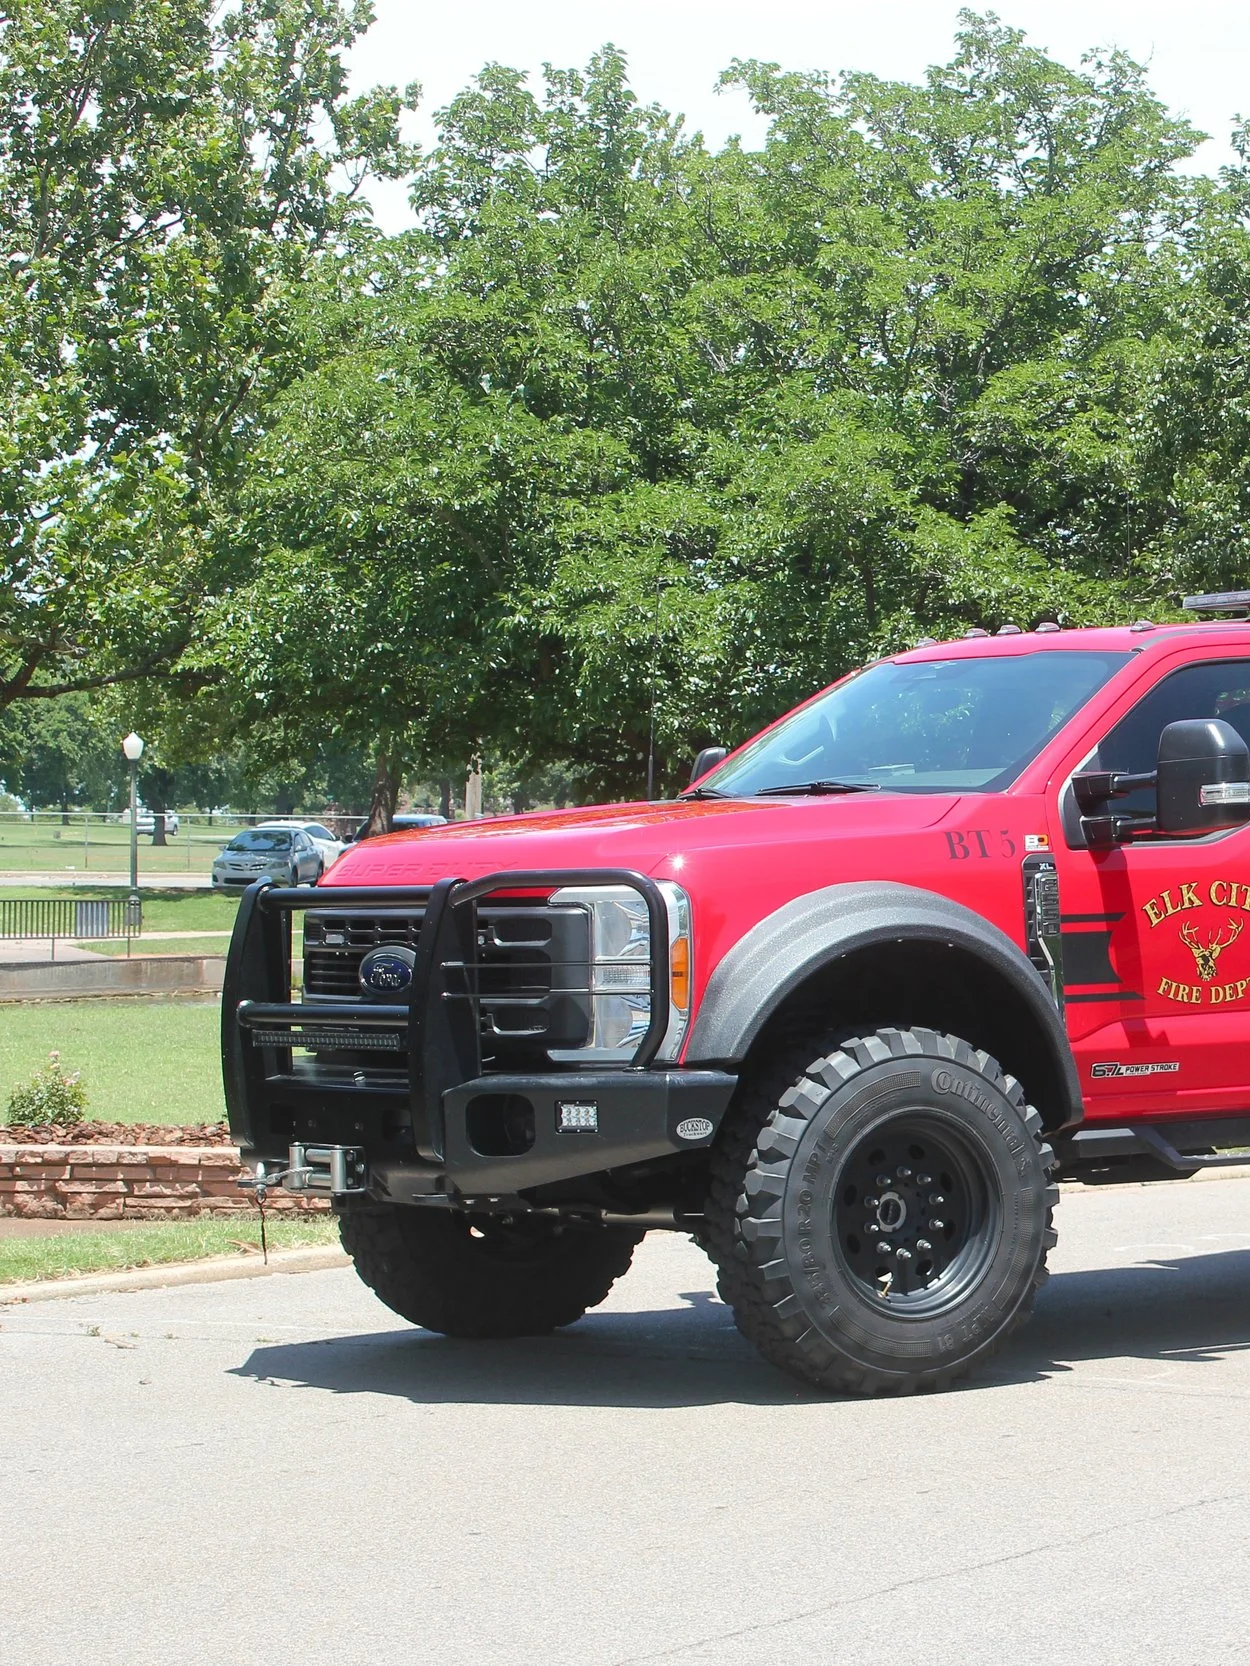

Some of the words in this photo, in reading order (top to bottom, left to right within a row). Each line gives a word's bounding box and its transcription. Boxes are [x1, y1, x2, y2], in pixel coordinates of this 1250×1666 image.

[943, 828, 992, 860] BT
[999, 829, 1016, 859] 5
[335, 862, 421, 879] SUPER
[1039, 862, 1054, 871] XL
[1142, 881, 1203, 928] ELK
[369, 962, 402, 987] Ford
[1156, 975, 1202, 1004] FIRE
[1091, 1062, 1124, 1078] 6.7L
[1124, 1065, 1150, 1074] POWER
[1150, 1063, 1178, 1072] STROKE
[930, 1067, 1027, 1156] Continental
[679, 1119, 711, 1133] BUCKSTOP
[801, 1137, 830, 1186] MPT
